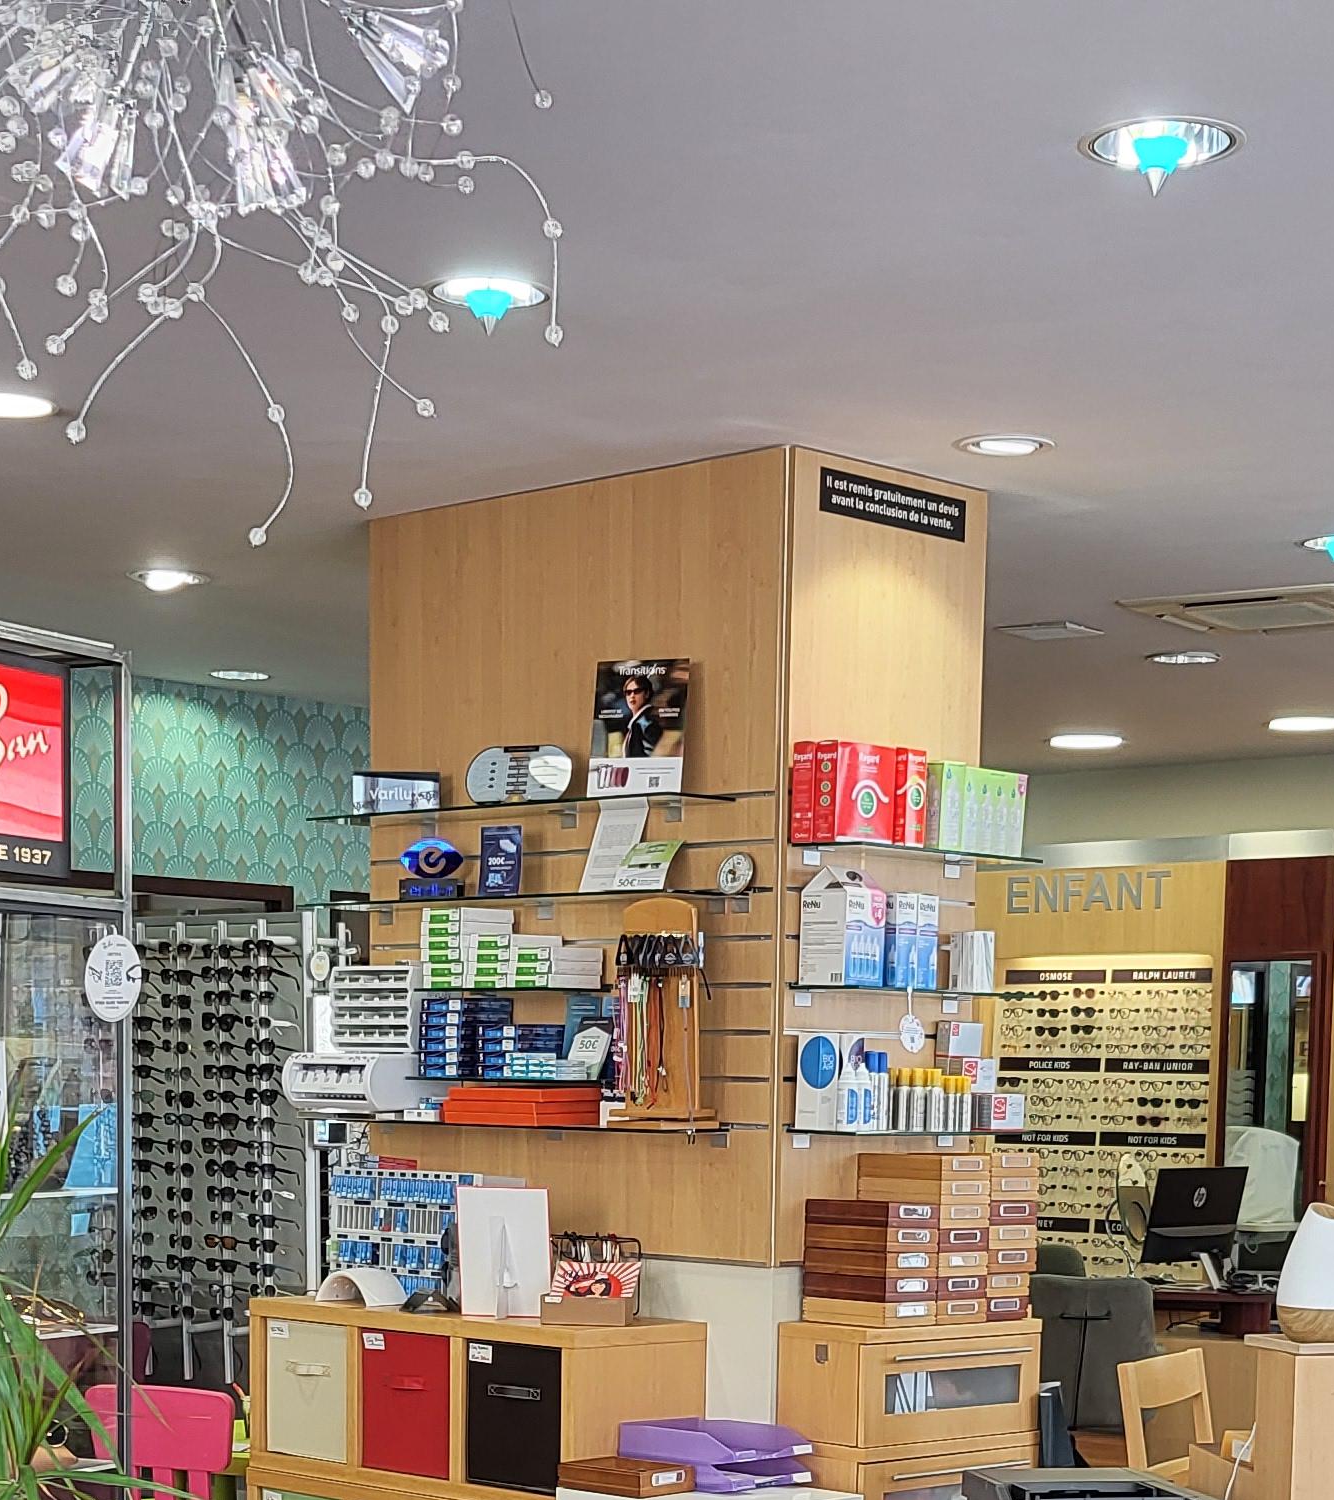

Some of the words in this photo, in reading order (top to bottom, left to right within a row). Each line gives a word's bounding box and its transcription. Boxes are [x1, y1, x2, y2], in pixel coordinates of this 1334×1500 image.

[826, 475, 833, 488] Il
[834, 478, 848, 491] est
[848, 483, 873, 497] remis
[874, 487, 926, 509] gratuitement
[927, 501, 938, 512] un
[938, 502, 959, 517] devis
[831, 493, 855, 509] avant
[855, 497, 864, 510] la
[864, 501, 908, 521] conclusion
[908, 511, 919, 523] de
[920, 512, 929, 524] la
[929, 516, 954, 531] vente.
[13, 846, 52, 866] 1937
[1007, 870, 1172, 915] ENFANT
[1039, 972, 1073, 982] OSMOSE
[1132, 971, 1160, 982] RALPH
[1162, 970, 1196, 981] LAUREN
[578, 1038, 599, 1050] 50€
[1028, 1060, 1053, 1070] POLICE
[1053, 1060, 1071, 1070] KIDS
[1122, 1061, 1160, 1071] RAY-BAN
[1162, 1061, 1194, 1071] JUNIOR
[1021, 1133, 1035, 1142] NOT
[1036, 1133, 1052, 1143] FOR
[1052, 1134, 1069, 1143] KIDS
[1127, 1135, 1142, 1145] NOT
[1143, 1136, 1158, 1145] FOR
[1159, 1136, 1178, 1145] KIDS
